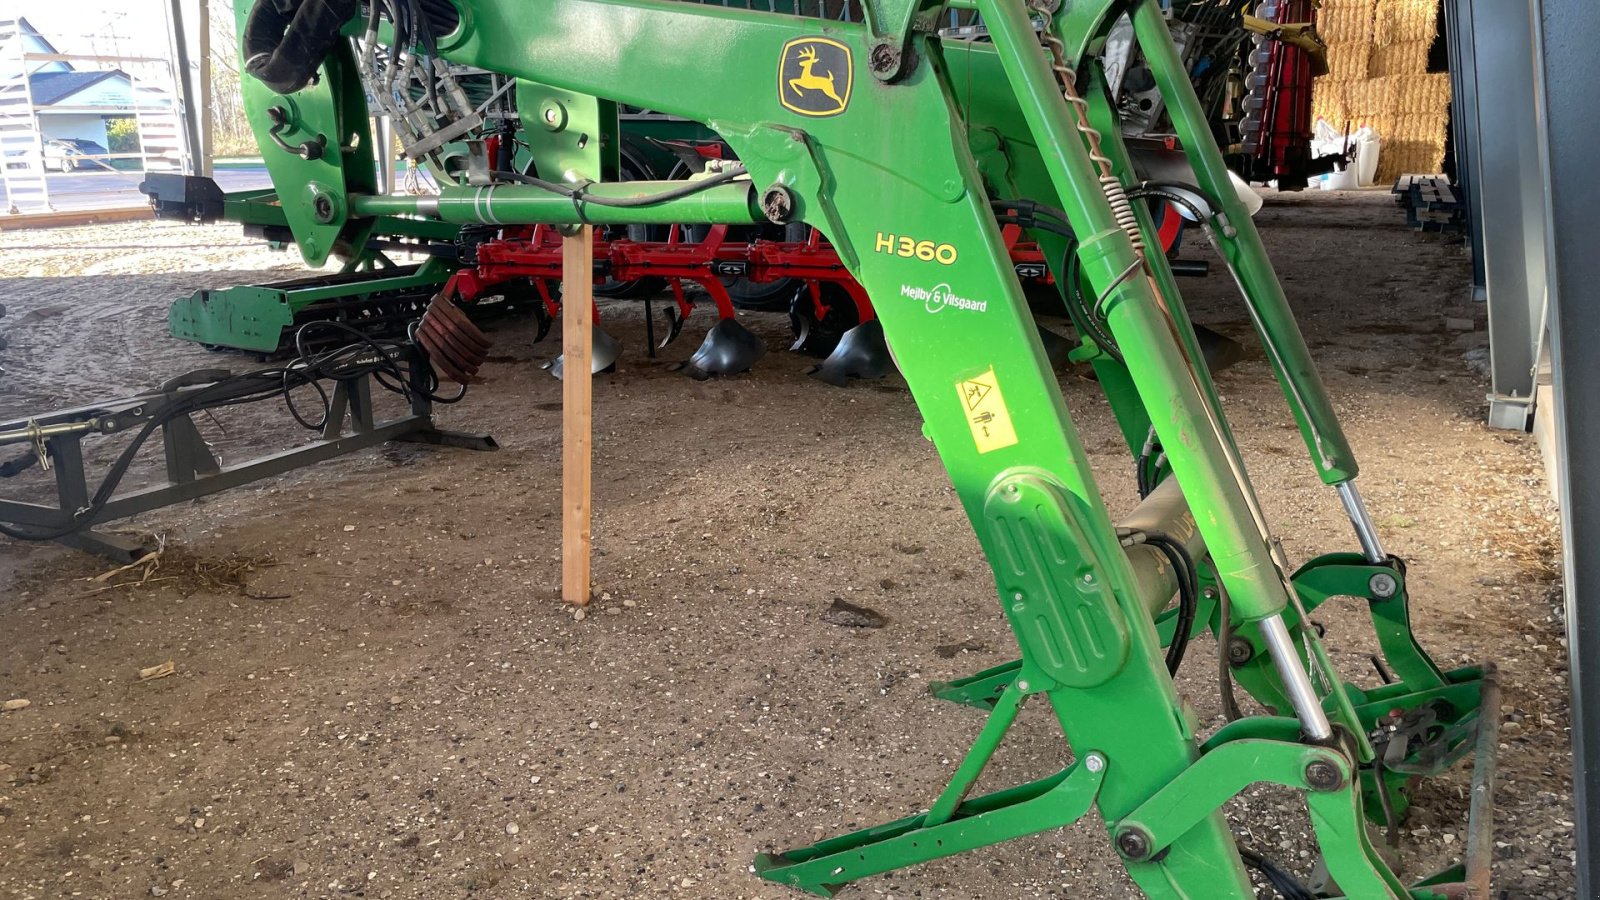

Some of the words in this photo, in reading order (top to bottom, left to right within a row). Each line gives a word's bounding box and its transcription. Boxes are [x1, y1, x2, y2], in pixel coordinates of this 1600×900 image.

[901, 284, 931, 303] Mejlby
[933, 291, 941, 302] &
[943, 292, 987, 312] Vilsgaard
